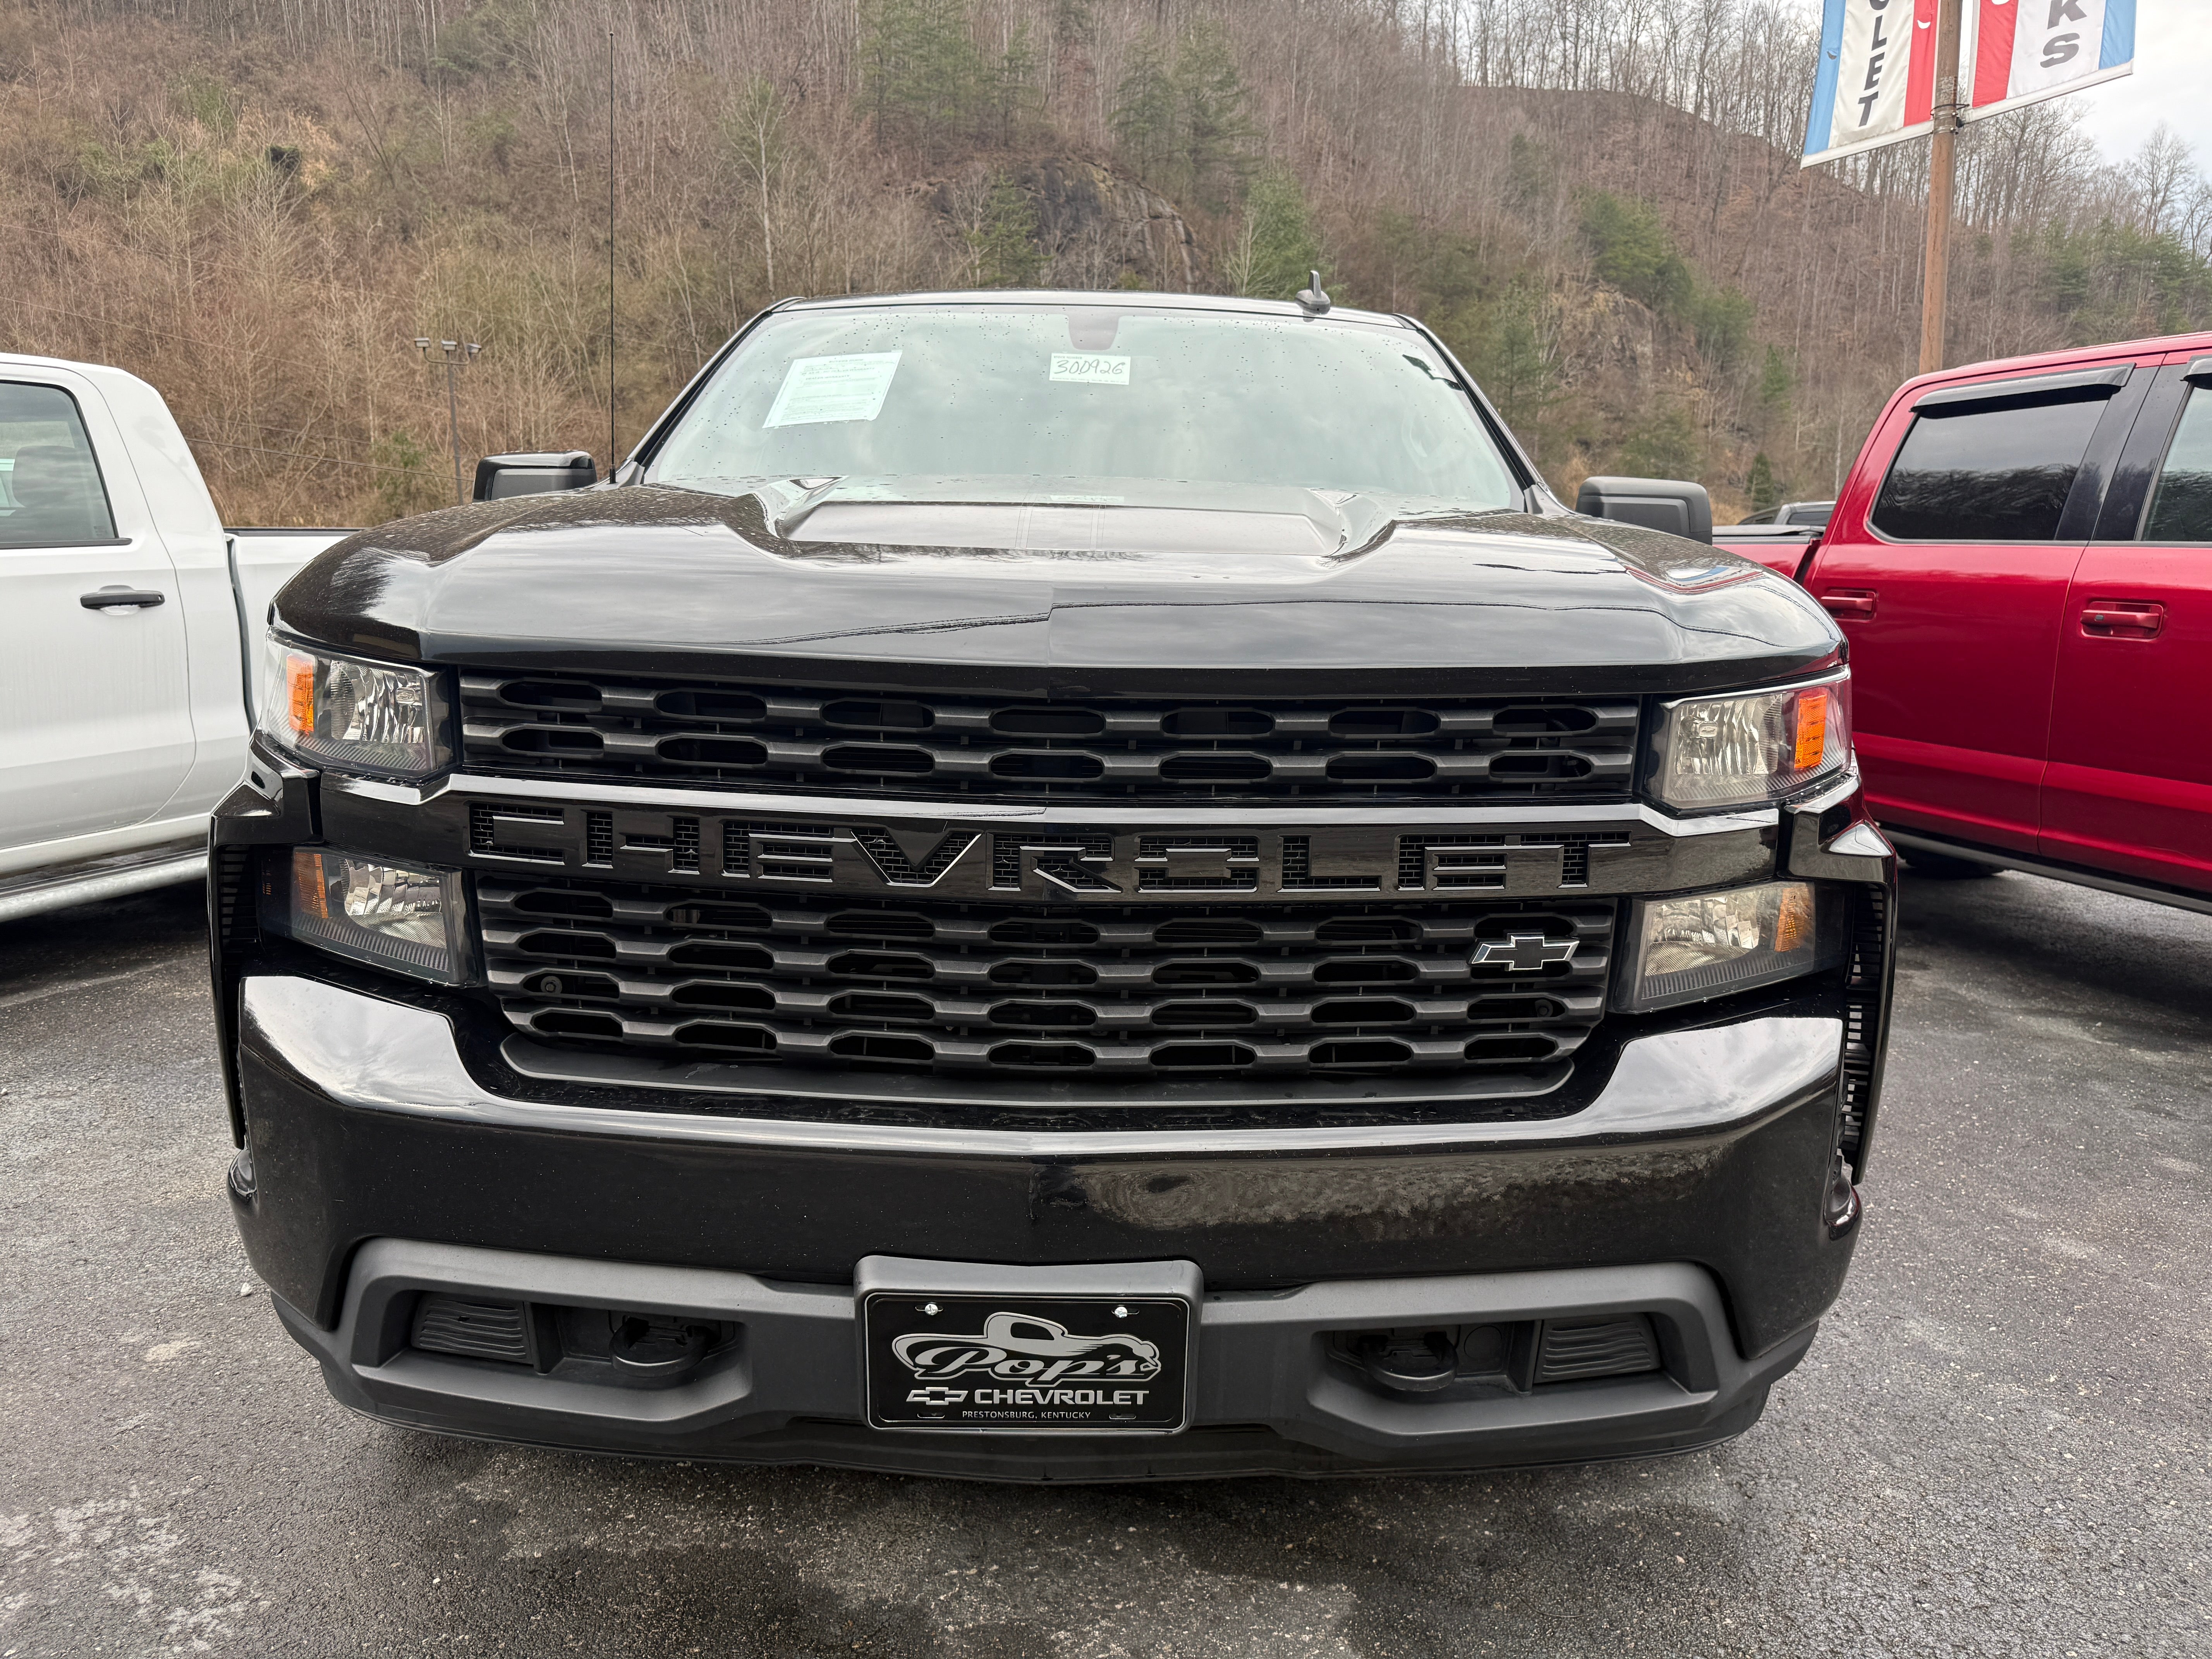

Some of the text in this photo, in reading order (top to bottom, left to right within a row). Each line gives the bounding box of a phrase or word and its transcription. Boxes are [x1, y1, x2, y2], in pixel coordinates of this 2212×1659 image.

[1054, 359, 1125, 374] 300926
[469, 802, 1632, 893] CHEVROLET
[914, 1346, 1145, 1381] Pop's
[974, 1389, 1149, 1405] CHEVROLET
[962, 1411, 1037, 1419] PRESTONSBURG,
